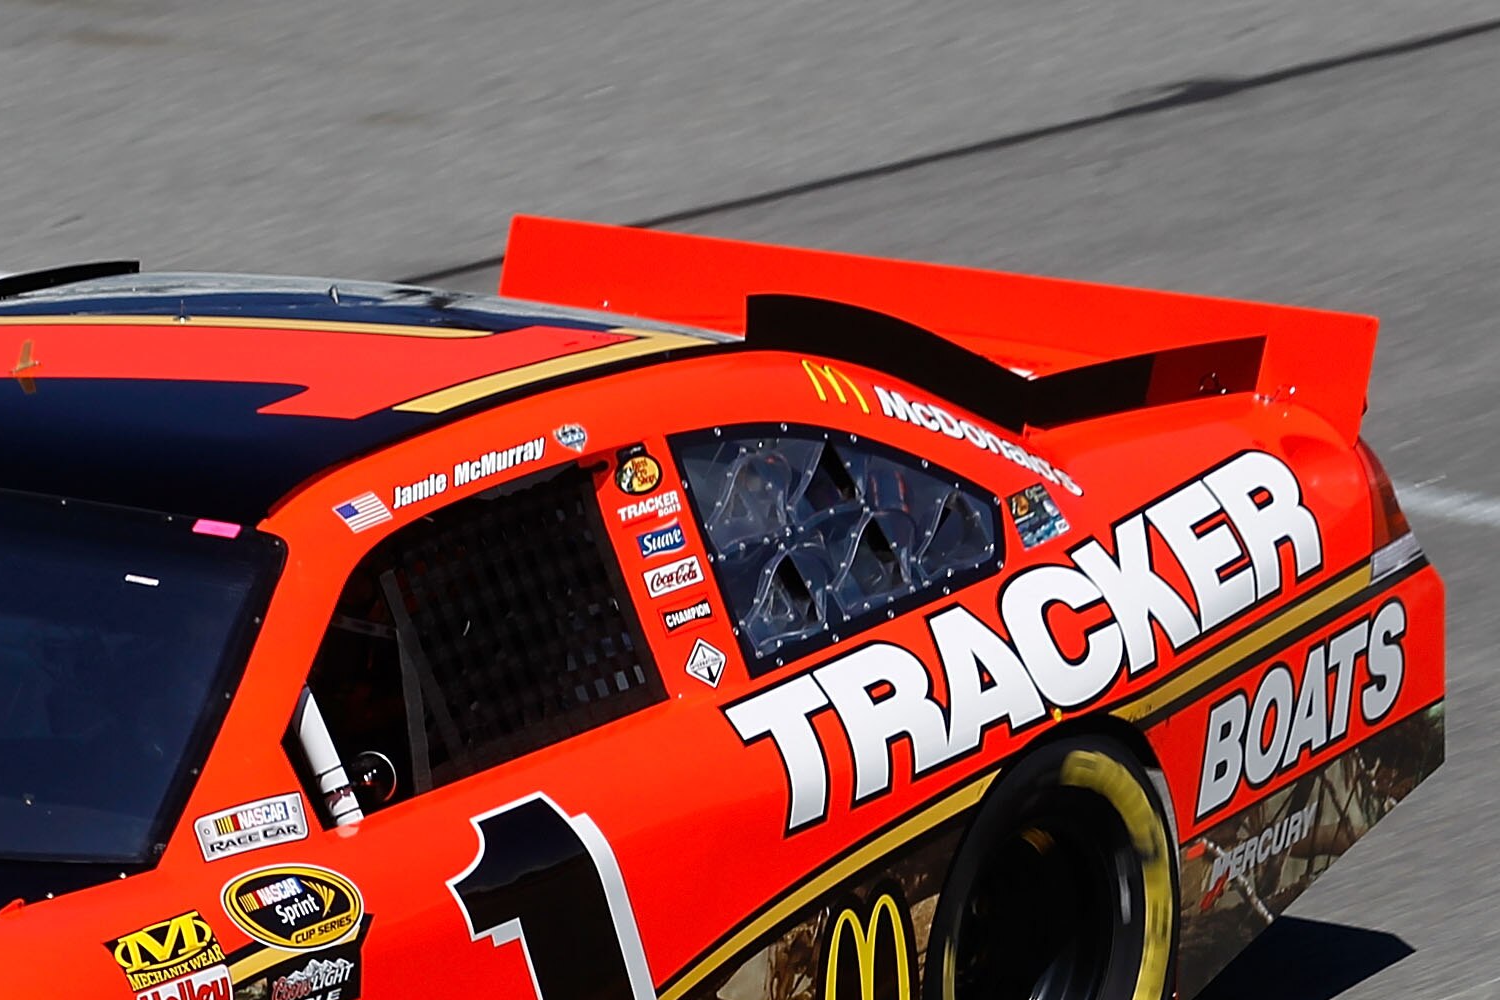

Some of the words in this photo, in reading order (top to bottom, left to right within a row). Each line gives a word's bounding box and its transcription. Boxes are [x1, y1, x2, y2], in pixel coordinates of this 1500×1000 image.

[393, 473, 447, 510] Jamie
[453, 437, 545, 486] McMurray
[617, 490, 679, 520] TRACKER
[658, 503, 681, 518] BOATS
[643, 528, 683, 555] Suave
[666, 602, 711, 627] CHAMPION
[726, 452, 1322, 830] TRACKER
[1197, 601, 1406, 817] BOATS
[237, 802, 287, 830] NASCAR
[209, 831, 261, 853] RACE
[262, 823, 299, 839] CAR
[1209, 800, 1318, 891] MERCURY
[257, 877, 301, 907] NASCAR
[275, 894, 320, 925] Sprint
[295, 929, 316, 944] CUP
[317, 915, 352, 936] SERIES
[127, 964, 190, 991] MECHANIX
[189, 944, 225, 972] WEAR
[311, 963, 354, 991] LIGHT
